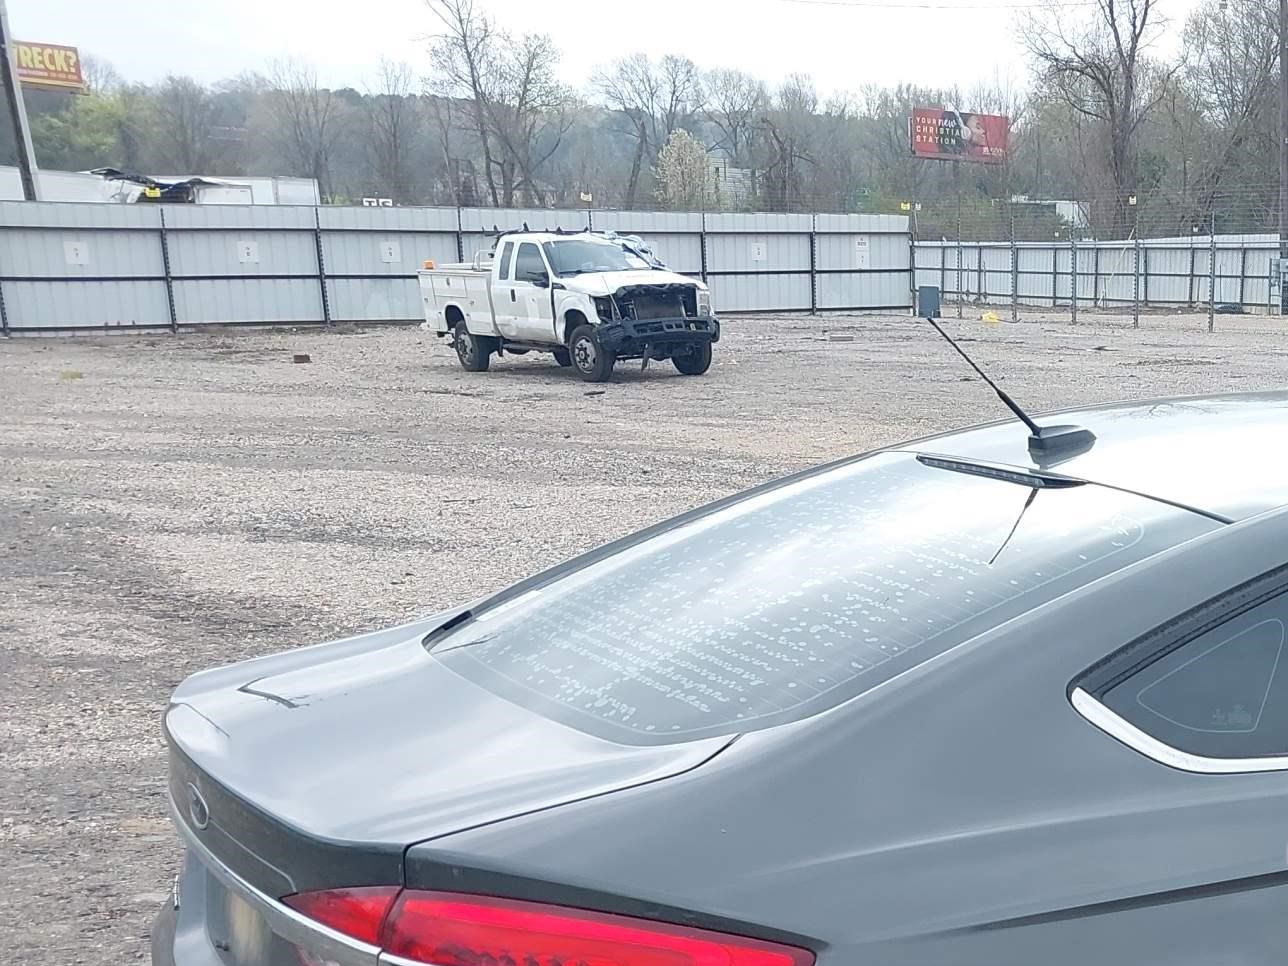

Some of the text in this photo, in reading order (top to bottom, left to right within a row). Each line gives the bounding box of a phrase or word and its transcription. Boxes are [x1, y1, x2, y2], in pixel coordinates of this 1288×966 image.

[16, 46, 77, 73] RECK?
[916, 117, 936, 125] YOUR
[916, 125, 962, 137] CHRISTIA
[916, 134, 956, 145] STATION
